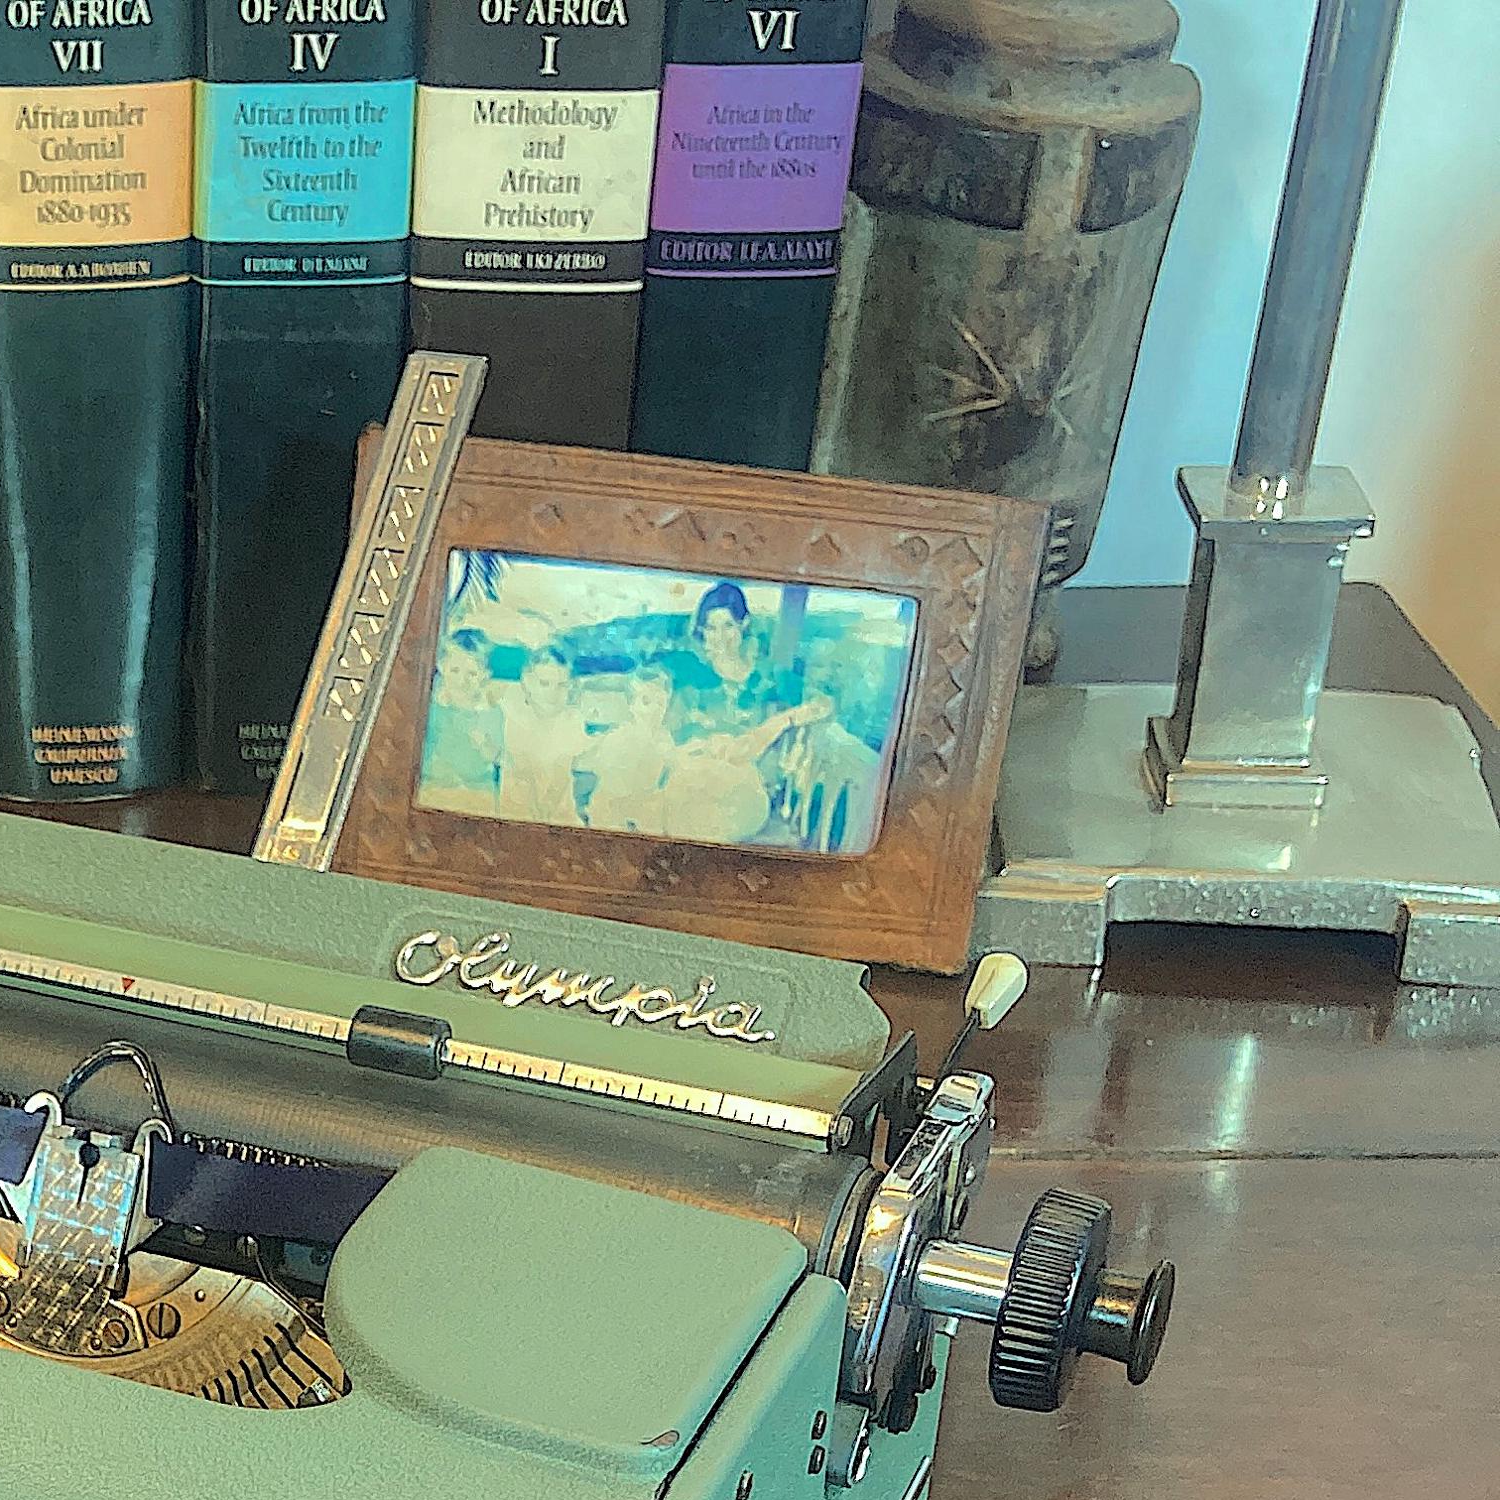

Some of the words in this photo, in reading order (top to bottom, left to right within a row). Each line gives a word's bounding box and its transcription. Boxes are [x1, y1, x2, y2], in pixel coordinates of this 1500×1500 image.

[7, 0, 45, 28] OF
[51, 0, 152, 27] AFRICA
[240, 0, 277, 23] OF
[285, 0, 385, 23] AFRICA
[481, 0, 518, 24] OF
[525, 0, 628, 25] AFRICA
[747, 9, 801, 50] VI
[52, 39, 103, 72] VII
[289, 33, 339, 71] IV
[539, 35, 560, 76] I
[15, 103, 79, 130] Africa
[83, 101, 147, 127] under
[234, 101, 294, 126] Africa
[300, 101, 349, 126] from
[355, 100, 388, 124] the
[473, 99, 618, 131] Methodology
[707, 103, 759, 125] Africa
[786, 102, 815, 124] the
[40, 133, 125, 162] Colonial
[241, 134, 317, 159] Twelfth
[323, 138, 345, 158] to
[350, 134, 382, 158] the
[522, 134, 565, 160] and
[19, 169, 147, 194] Domination
[263, 168, 358, 192] Sixteenth
[500, 167, 581, 194] African
[266, 199, 349, 227] Century
[484, 201, 595, 233] Prehistory
[395, 928, 777, 1043] Olympia
